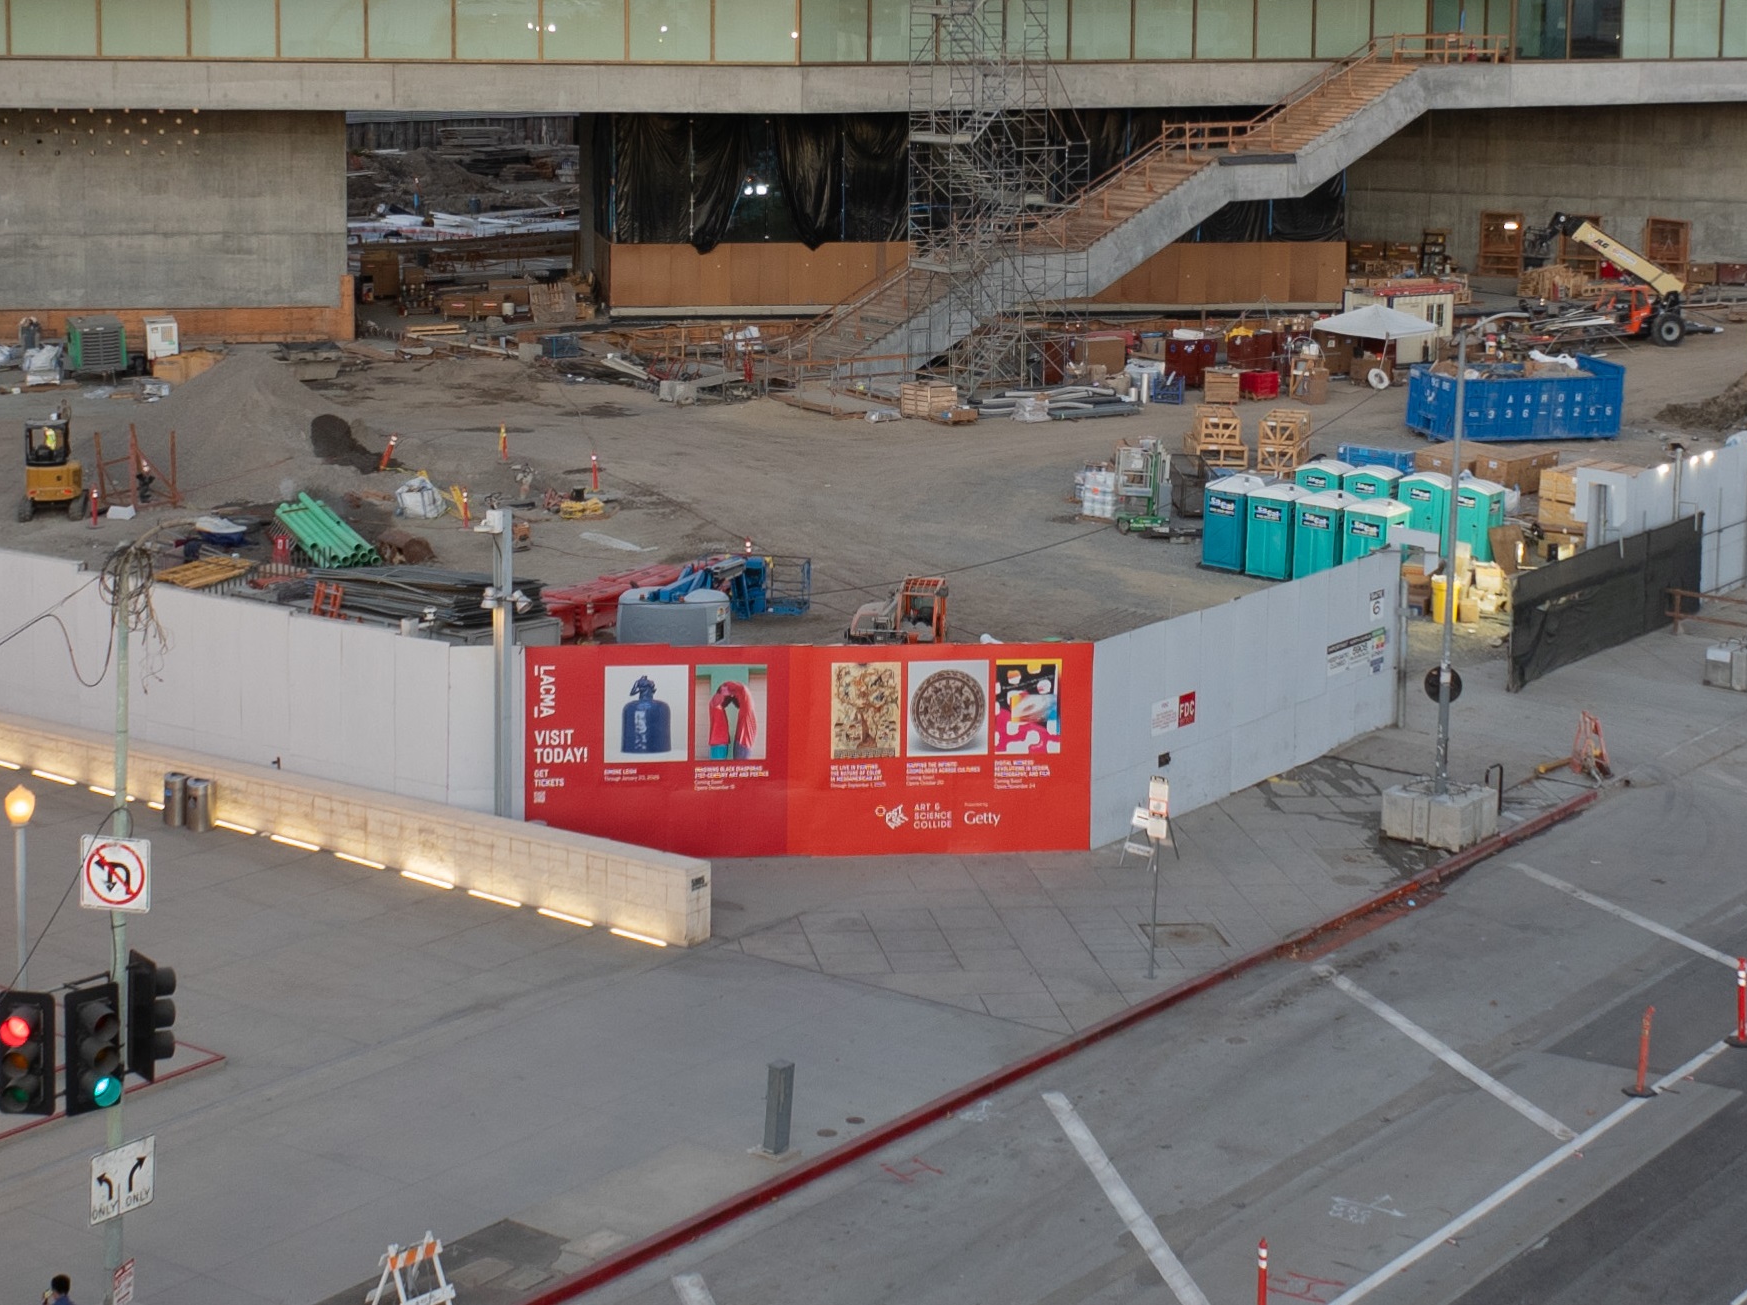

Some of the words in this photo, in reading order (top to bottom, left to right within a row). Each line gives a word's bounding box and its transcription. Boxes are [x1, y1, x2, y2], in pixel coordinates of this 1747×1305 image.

[1373, 601, 1381, 615] 6
[538, 665, 556, 718] LACMA
[1179, 700, 1195, 719] FDC
[534, 730, 574, 745] VISIT
[534, 747, 588, 764] TODAY!
[534, 769, 549, 778] GET
[534, 778, 565, 787] TICKETS
[914, 803, 931, 811] ART
[934, 802, 940, 810] &
[914, 811, 952, 820] SCIENCE
[964, 810, 1001, 827] Getty
[914, 820, 952, 829] COLLIDE
[125, 1187, 150, 1207] ONLY
[92, 1201, 119, 1221] ONLY
